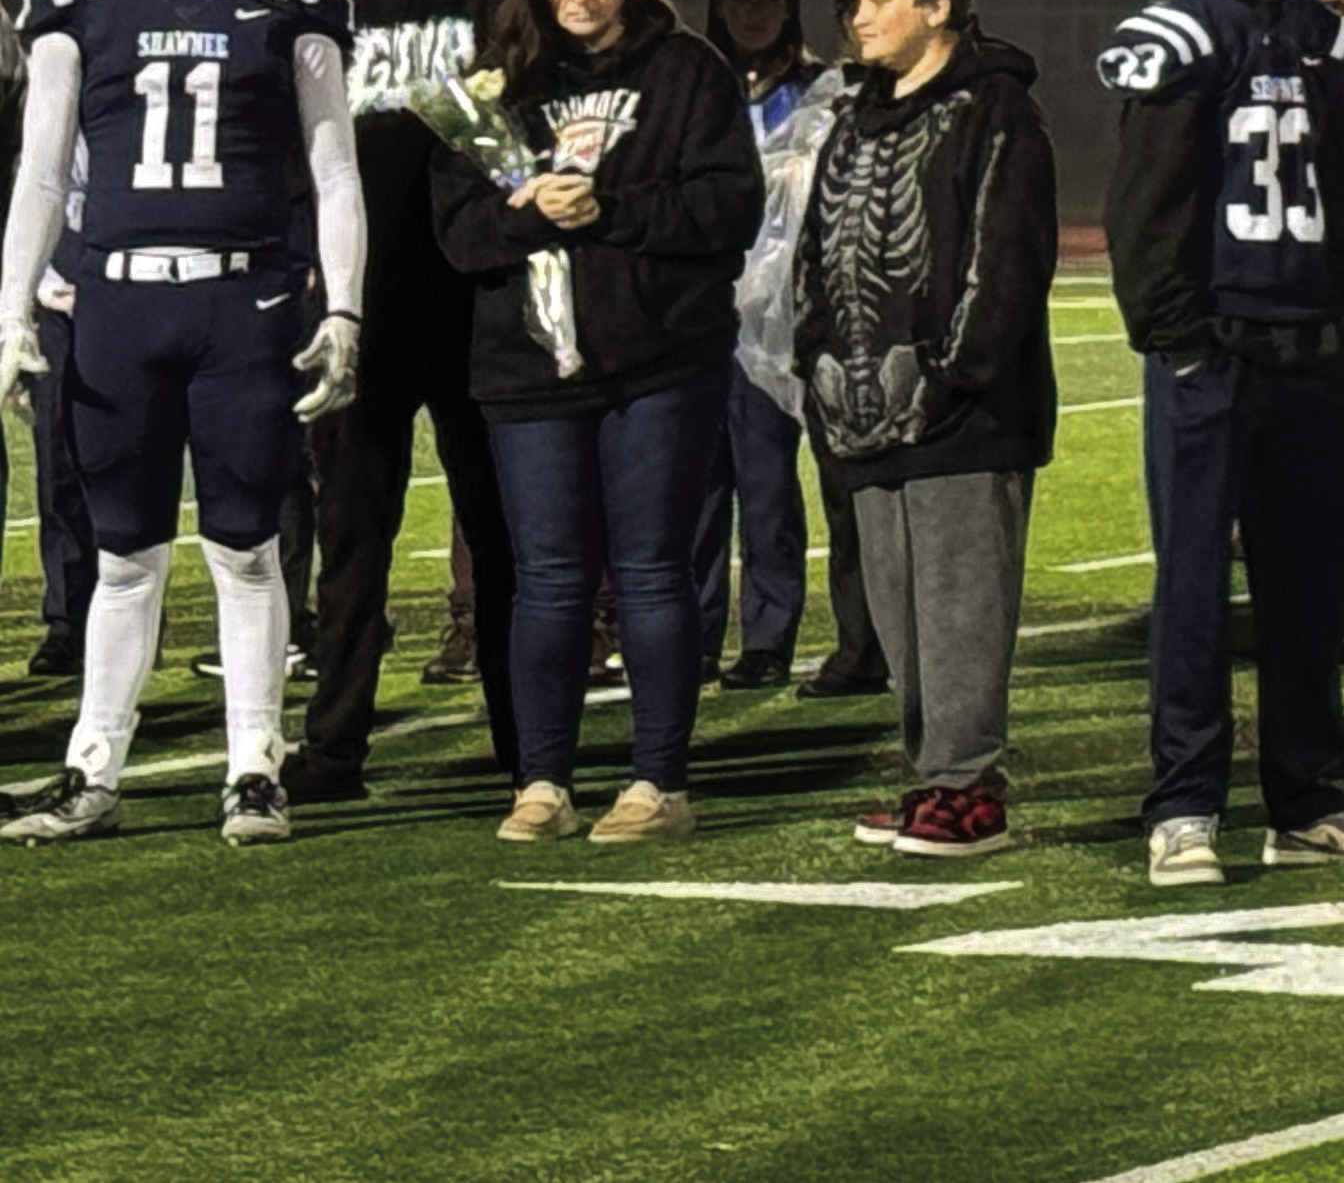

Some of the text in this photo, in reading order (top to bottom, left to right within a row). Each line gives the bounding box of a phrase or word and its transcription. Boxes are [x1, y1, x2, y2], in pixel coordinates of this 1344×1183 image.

[138, 30, 230, 59] SHAWNEE
[132, 61, 224, 189] 11
[1226, 105, 1325, 242] 33
